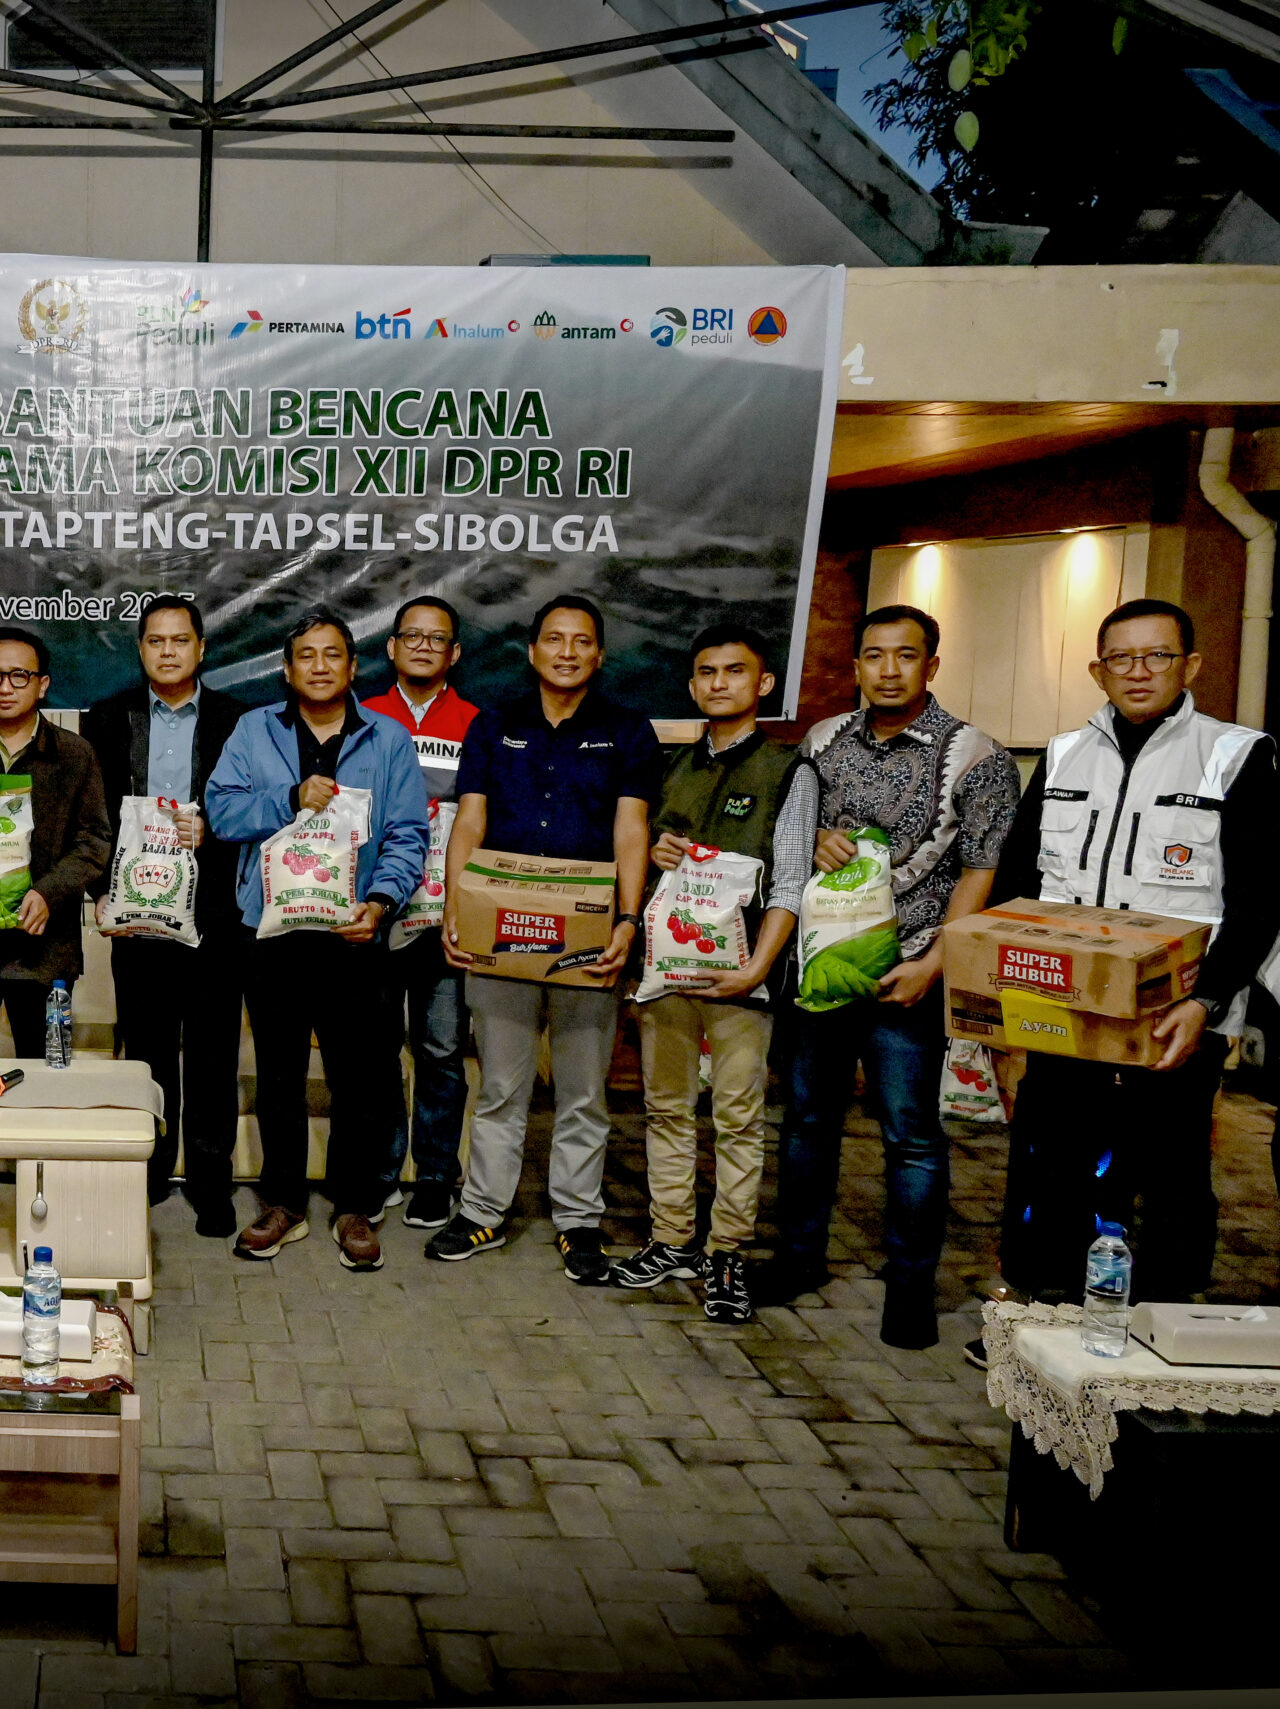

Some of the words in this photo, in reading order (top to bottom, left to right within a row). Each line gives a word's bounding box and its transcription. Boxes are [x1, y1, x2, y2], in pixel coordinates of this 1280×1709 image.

[355, 308, 411, 340] btn
[692, 308, 733, 331] BRI
[269, 322, 345, 334] PERTAMINA
[453, 324, 504, 339] Inalum
[691, 333, 733, 346] peduli
[267, 388, 551, 441] BENCANA
[133, 445, 338, 498] KOMISI
[352, 447, 431, 499] XII
[442, 448, 562, 499] DPR
[577, 448, 632, 499] RI
[1175, 795, 1199, 806] BRI
[302, 818, 331, 831] ND
[311, 832, 336, 842] APEL
[141, 843, 166, 855] RAJA
[428, 848, 444, 856] PEL
[286, 889, 304, 899] PEM
[311, 889, 338, 901] JOHAR
[676, 893, 693, 903] CAP
[694, 898, 720, 908] APEL
[283, 905, 315, 914] BRUTTO
[326, 906, 336, 916] kg
[504, 912, 556, 928] SUPER
[501, 924, 559, 941] BUBUR
[1006, 950, 1062, 971] SUPER
[1003, 963, 1066, 987] BUBUR
[1020, 1019, 1067, 1037] Ayam
